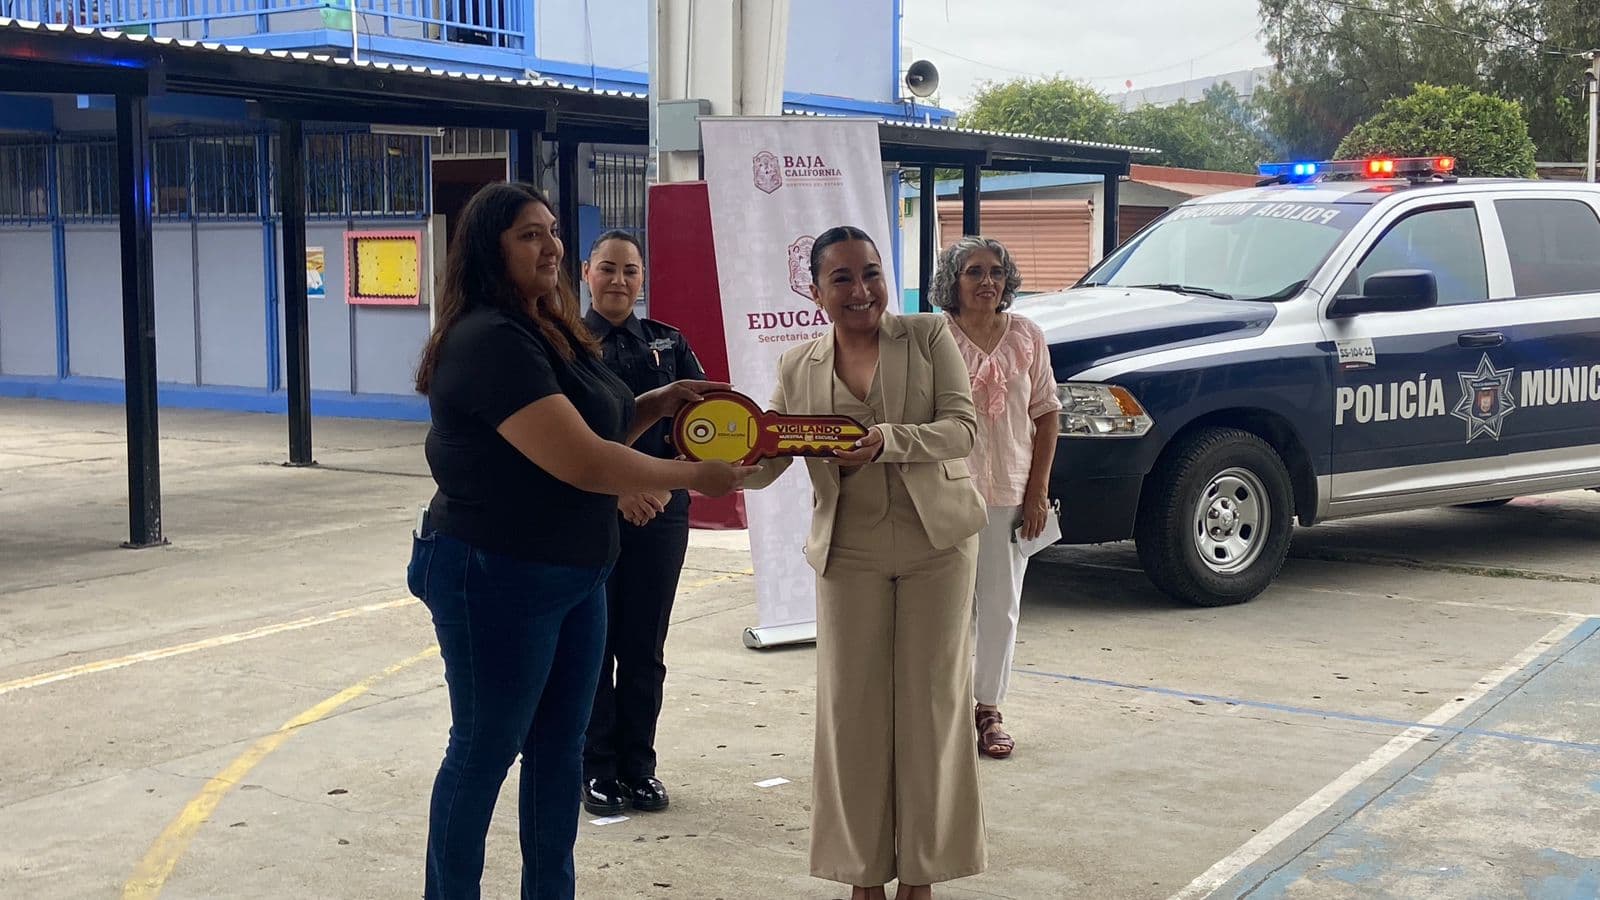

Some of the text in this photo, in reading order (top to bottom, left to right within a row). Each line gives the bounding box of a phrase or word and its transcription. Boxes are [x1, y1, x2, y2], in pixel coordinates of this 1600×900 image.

[784, 155, 825, 168] BAJA
[784, 168, 842, 177] CALIFORNIA
[1335, 364, 1600, 426] POLICÍA MUNIC
[776, 424, 842, 434] VIGILANDO
